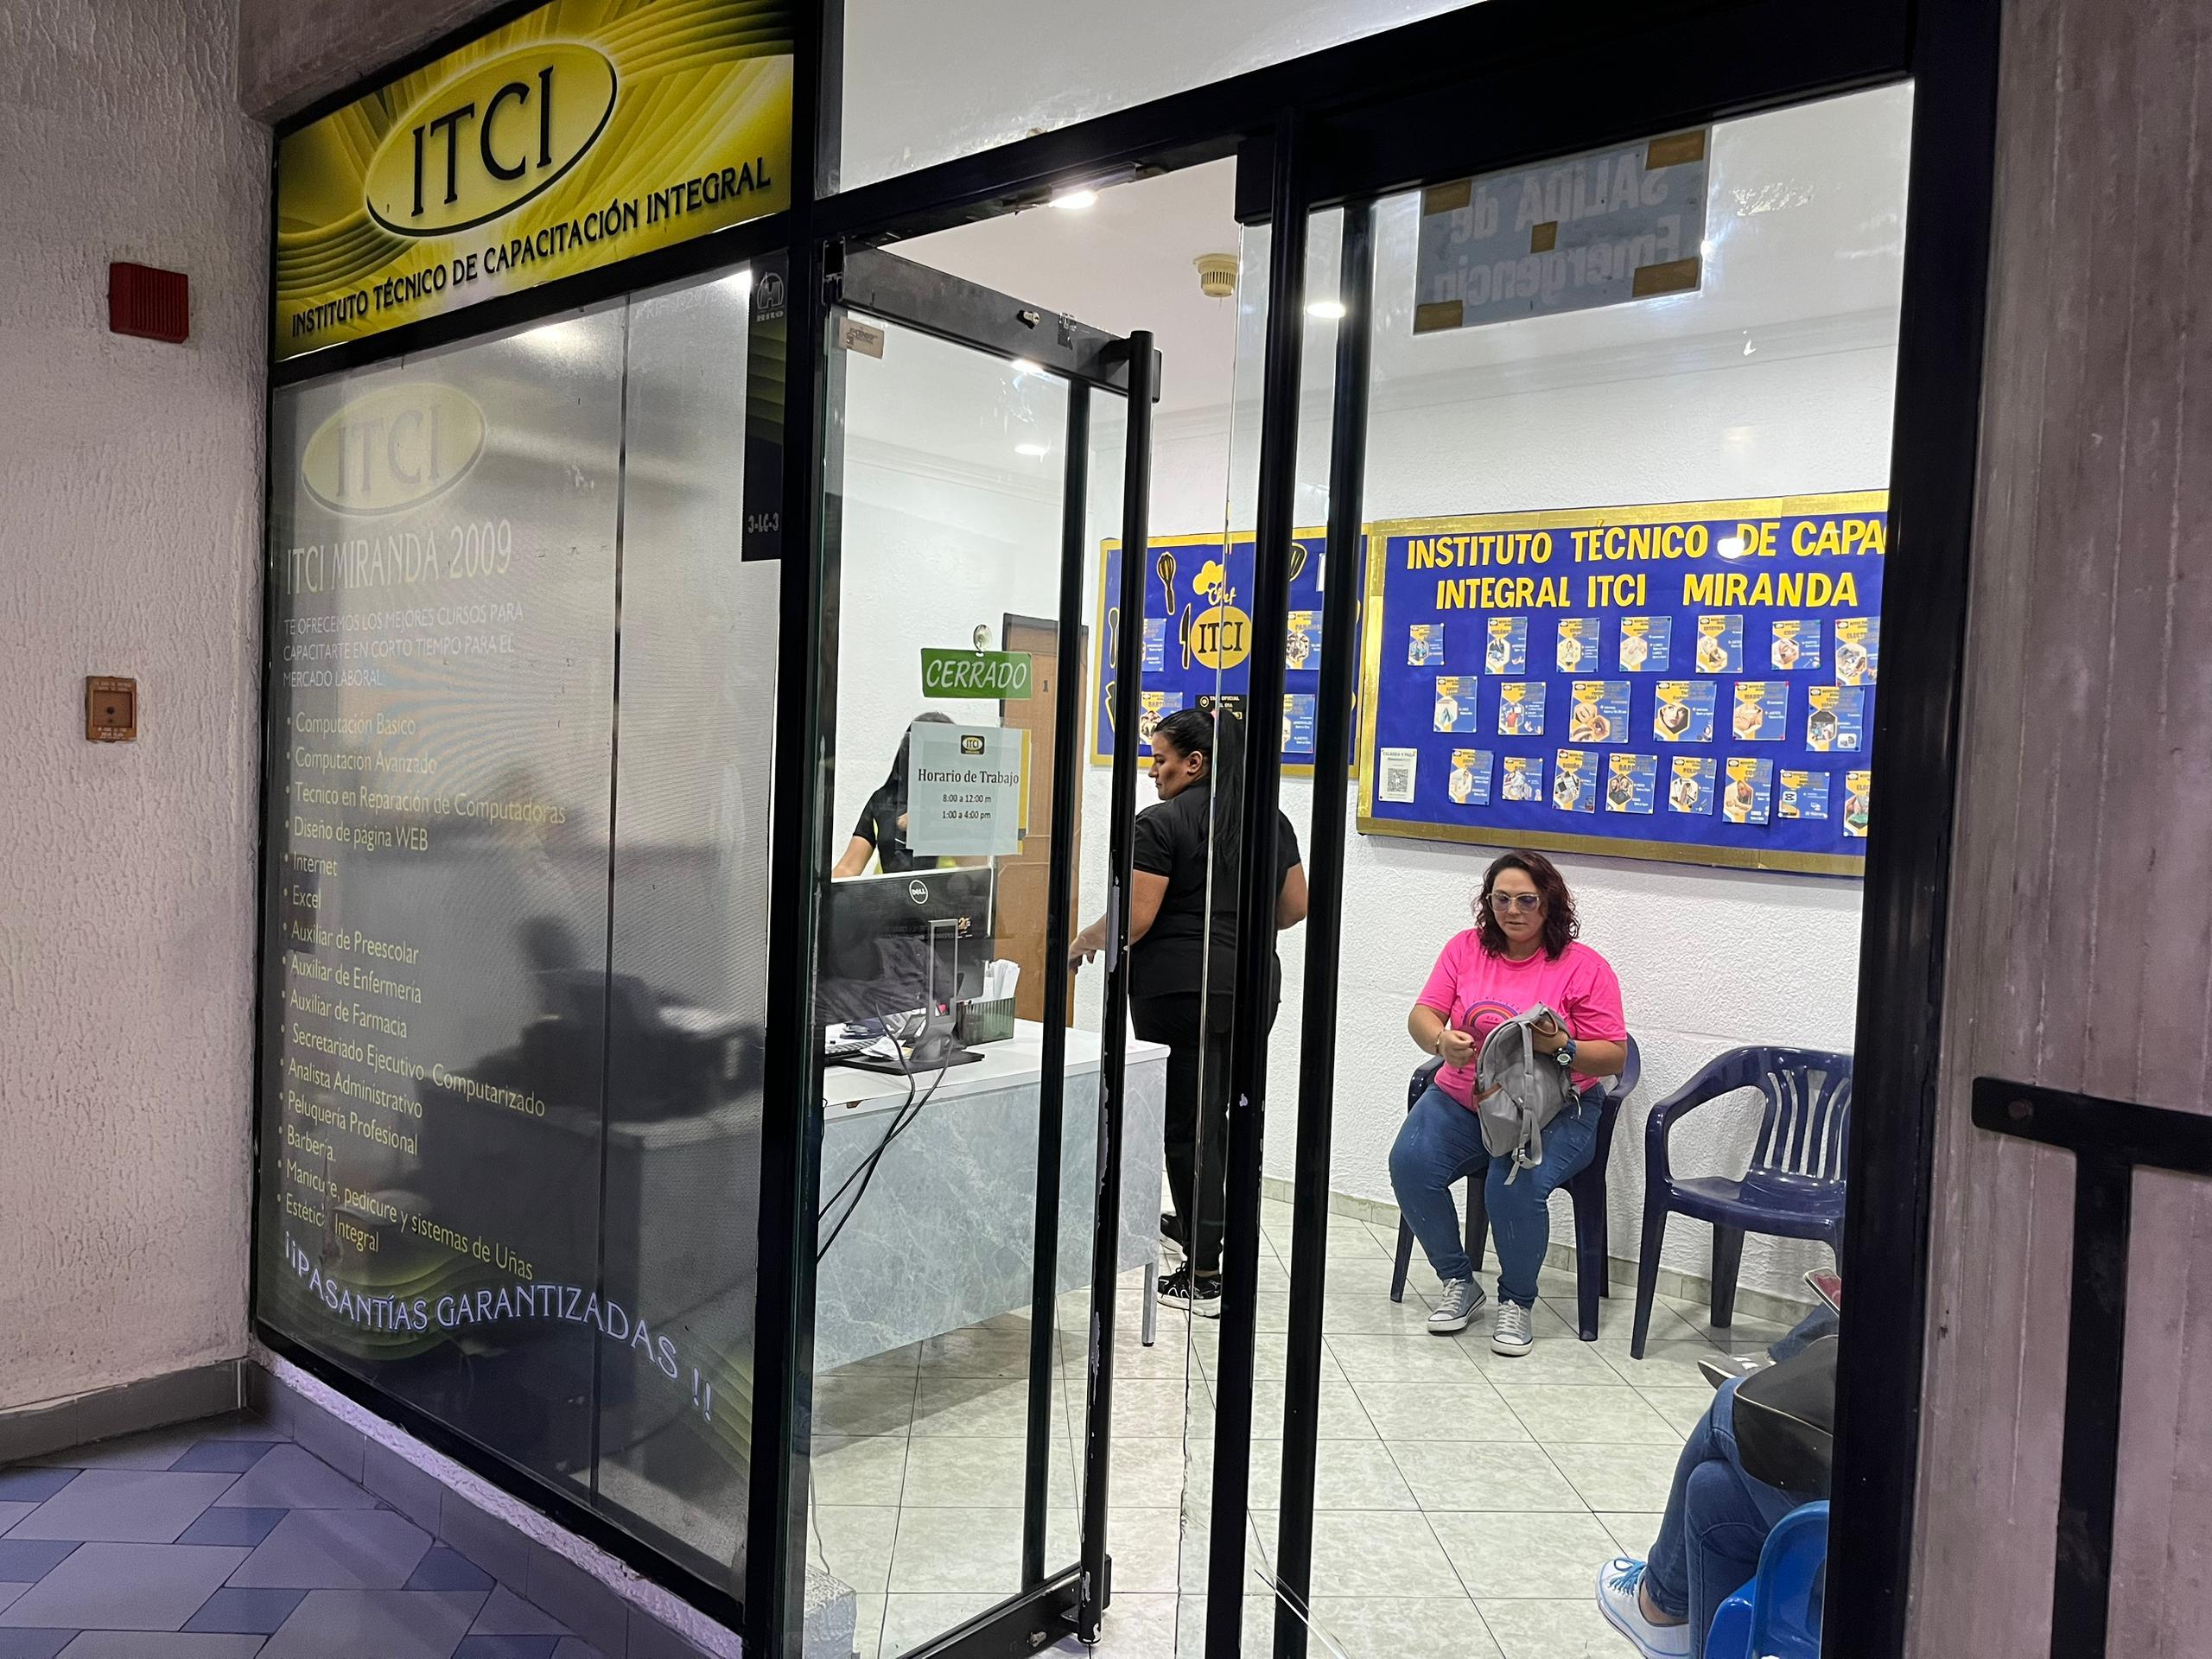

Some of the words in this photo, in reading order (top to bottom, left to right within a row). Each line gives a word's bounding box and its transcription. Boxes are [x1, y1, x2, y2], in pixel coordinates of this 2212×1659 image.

[410, 65, 554, 218] ITCI
[292, 293, 368, 338] INSTITUTO
[372, 264, 447, 309] TÉCNICO
[452, 257, 478, 284] DE
[483, 198, 639, 275] CAPACITACIÓN
[646, 156, 772, 223] INTEGRAL
[336, 404, 442, 498] ITCI
[286, 545, 325, 595] ITCI
[331, 531, 440, 590] MIRANDA
[448, 518, 512, 580] 2009
[1406, 531, 1553, 570] INSTITUTO
[1570, 518, 1708, 563] TÉCNICO
[1737, 521, 1777, 557] DE
[1790, 517, 1887, 557] CAPA
[1435, 575, 1571, 610] INTEGRAL
[1586, 573, 1647, 608] ITCI
[1681, 571, 1859, 609] MIRANDA
[283, 619, 296, 636] TE
[298, 613, 360, 635] OFRECEMOS
[361, 610, 383, 632] LOS
[385, 607, 435, 633] MEJORES
[436, 604, 487, 626] CURSOS
[489, 601, 524, 623] PARA
[1198, 620, 1244, 654] ITCI
[283, 639, 351, 662] CAPACITARTE
[353, 640, 369, 659] EN
[371, 637, 414, 658] CORTO
[415, 634, 461, 657] TIEMPO
[464, 634, 499, 654] PARA
[499, 633, 516, 653] EL
[283, 670, 334, 689] MERCADO
[334, 669, 385, 687] LABORAL
[926, 658, 1027, 690] CERRADO
[296, 711, 372, 740] Computación
[966, 739, 979, 749] ITCI
[374, 749, 437, 775] Avanzado
[918, 768, 962, 783] Horario
[963, 770, 977, 783] de
[979, 771, 1020, 787] Trabajo
[341, 790, 357, 806] en
[359, 785, 429, 815] Reparación
[434, 792, 450, 814] de
[454, 792, 566, 825] Computadoras
[942, 793, 958, 803] 8:00
[965, 794, 984, 803] 12:00
[942, 810, 957, 819] 1:00
[963, 810, 979, 819] 4:00
[980, 811, 992, 821] pm
[294, 816, 333, 841] Diseño
[335, 821, 351, 842] de
[353, 823, 392, 852] página
[395, 825, 429, 852] WEB
[293, 854, 338, 877] Internet
[292, 884, 321, 910] Excel
[912, 887, 926, 896] DELL
[291, 919, 334, 947] Auxiliar
[335, 928, 351, 950] de
[354, 931, 419, 964] Preescolar
[290, 954, 333, 982] Auxiliar
[335, 963, 350, 987] de
[353, 967, 423, 1005] Enfermería
[289, 988, 333, 1018] Auxiliar
[334, 999, 350, 1022] de
[353, 1003, 408, 1039] Farmacia
[289, 1057, 331, 1089] Analista
[334, 1071, 423, 1120] Administrativo
[292, 1022, 364, 1063] Secretariado
[366, 1044, 424, 1081] Ejecutivo
[431, 1064, 546, 1117] Computarizado
[288, 1090, 346, 1129] Peluquería
[349, 1110, 418, 1156] Profesional
[334, 1213, 379, 1253] Integral
[345, 1188, 398, 1224] pedicure
[400, 1211, 409, 1233] y
[411, 1213, 468, 1253] sistemas
[472, 1236, 491, 1262] de
[495, 1243, 534, 1281] Uñas
[436, 1282, 679, 1381] GARANTIZADAS
